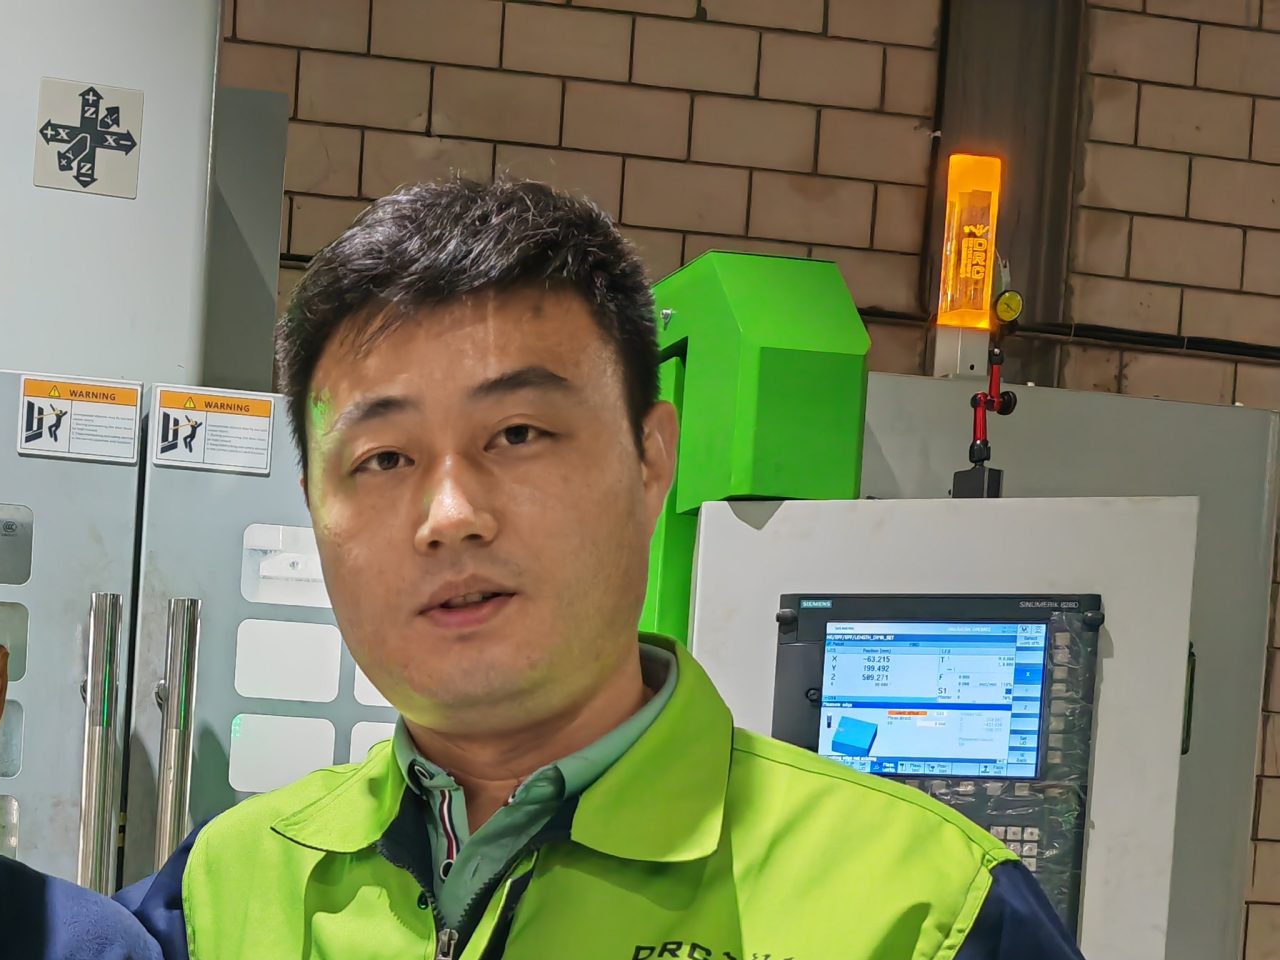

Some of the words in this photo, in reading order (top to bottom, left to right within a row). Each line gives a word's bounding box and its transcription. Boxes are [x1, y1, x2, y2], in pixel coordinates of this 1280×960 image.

[972, 238, 988, 279] DRC
[69, 389, 116, 401] WARNING
[204, 401, 250, 412] WARNING
[802, 600, 831, 608] SIEMENS
